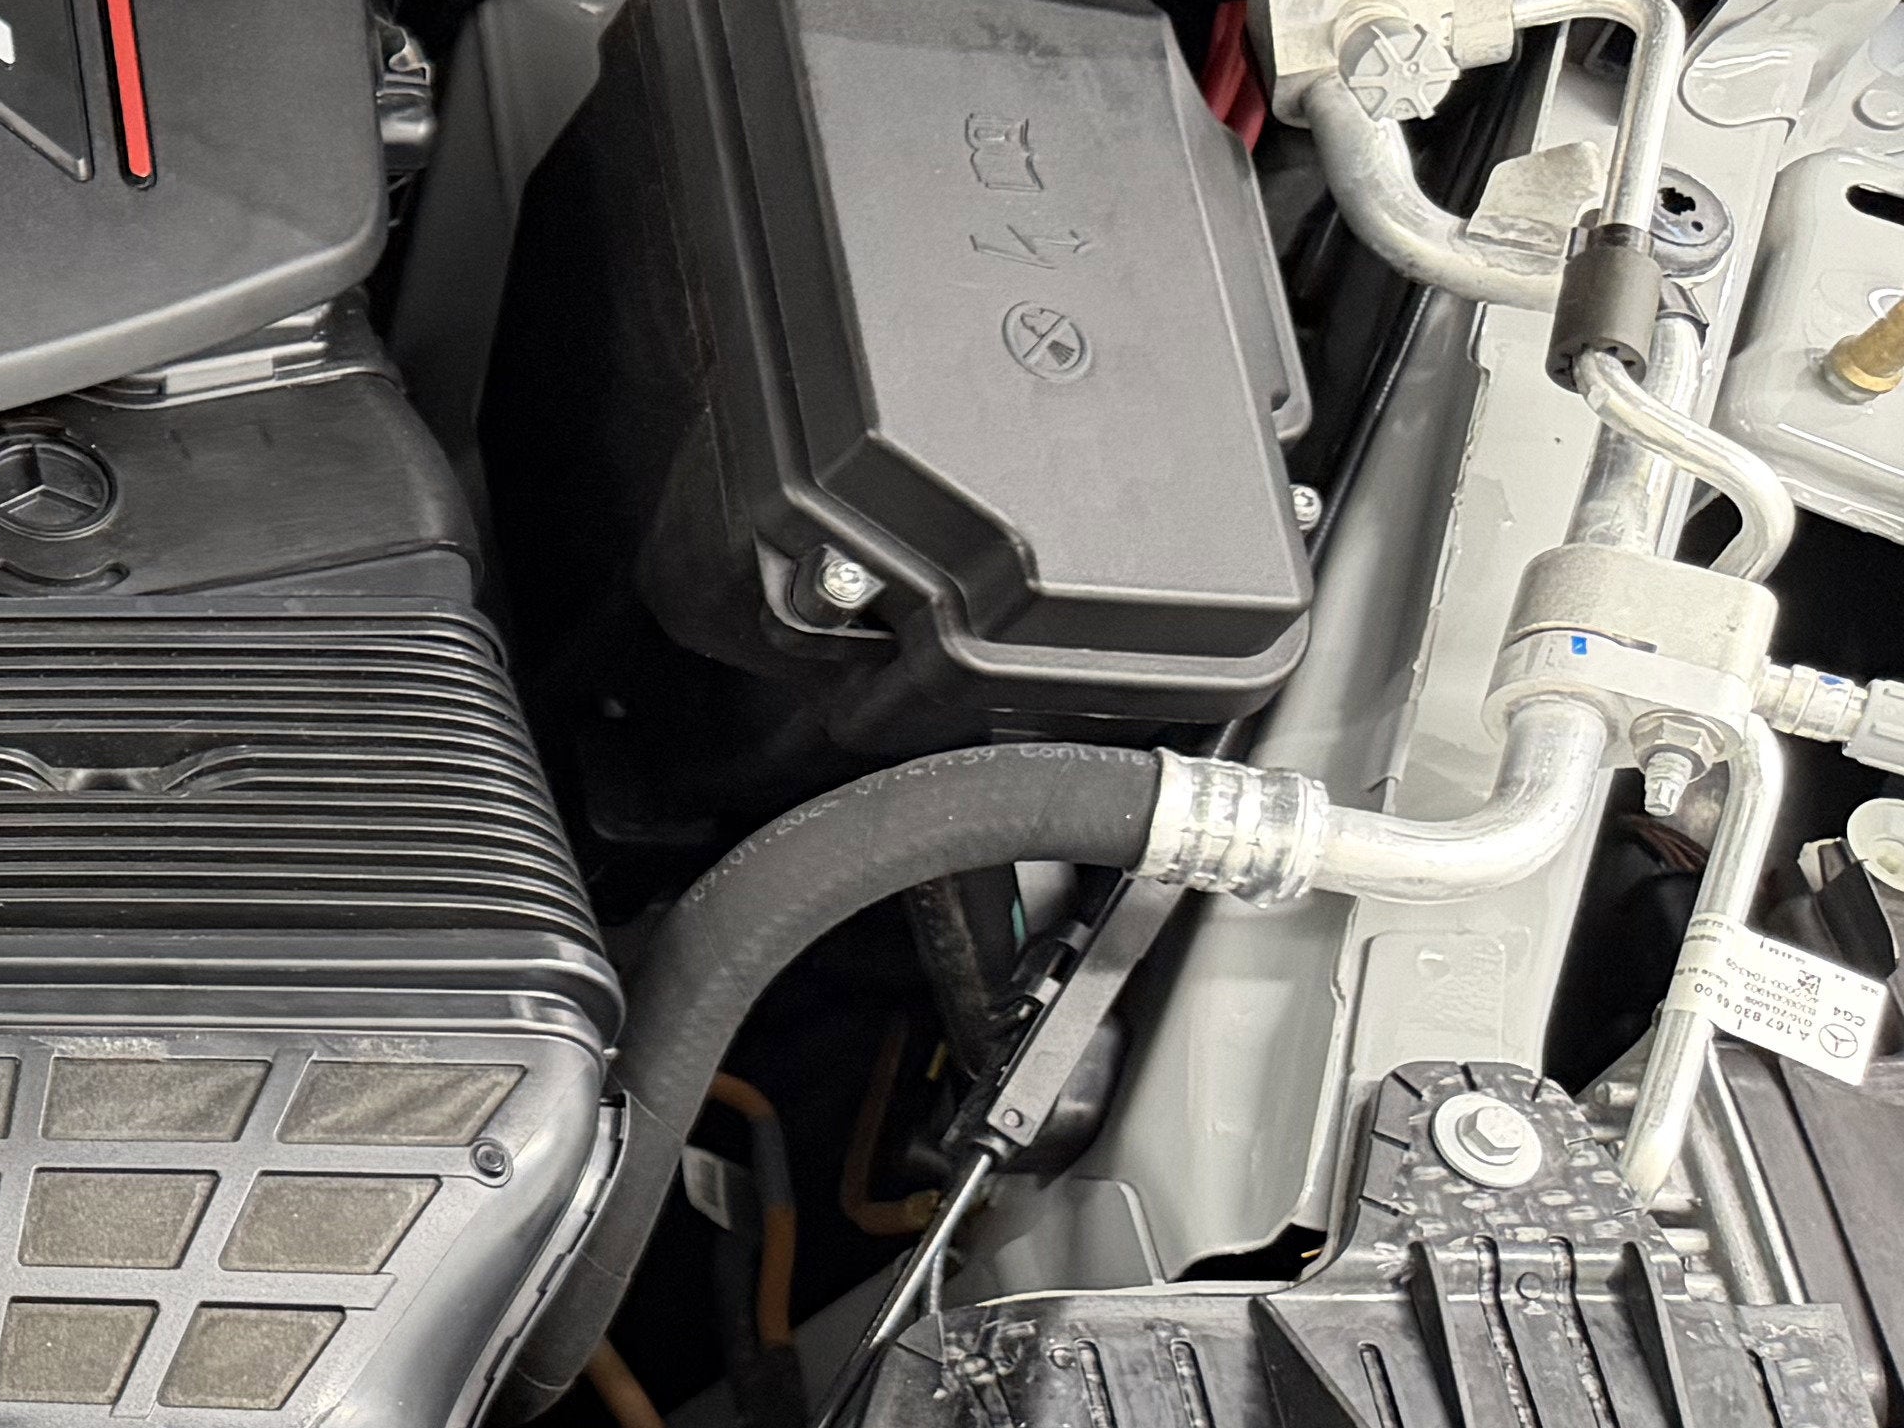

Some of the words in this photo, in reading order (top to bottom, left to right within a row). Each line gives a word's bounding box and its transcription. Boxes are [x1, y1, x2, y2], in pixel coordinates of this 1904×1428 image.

[1693, 982, 1713, 998] 00
[1735, 1003, 1761, 1022] 830
[1798, 1030, 1811, 1042] A
